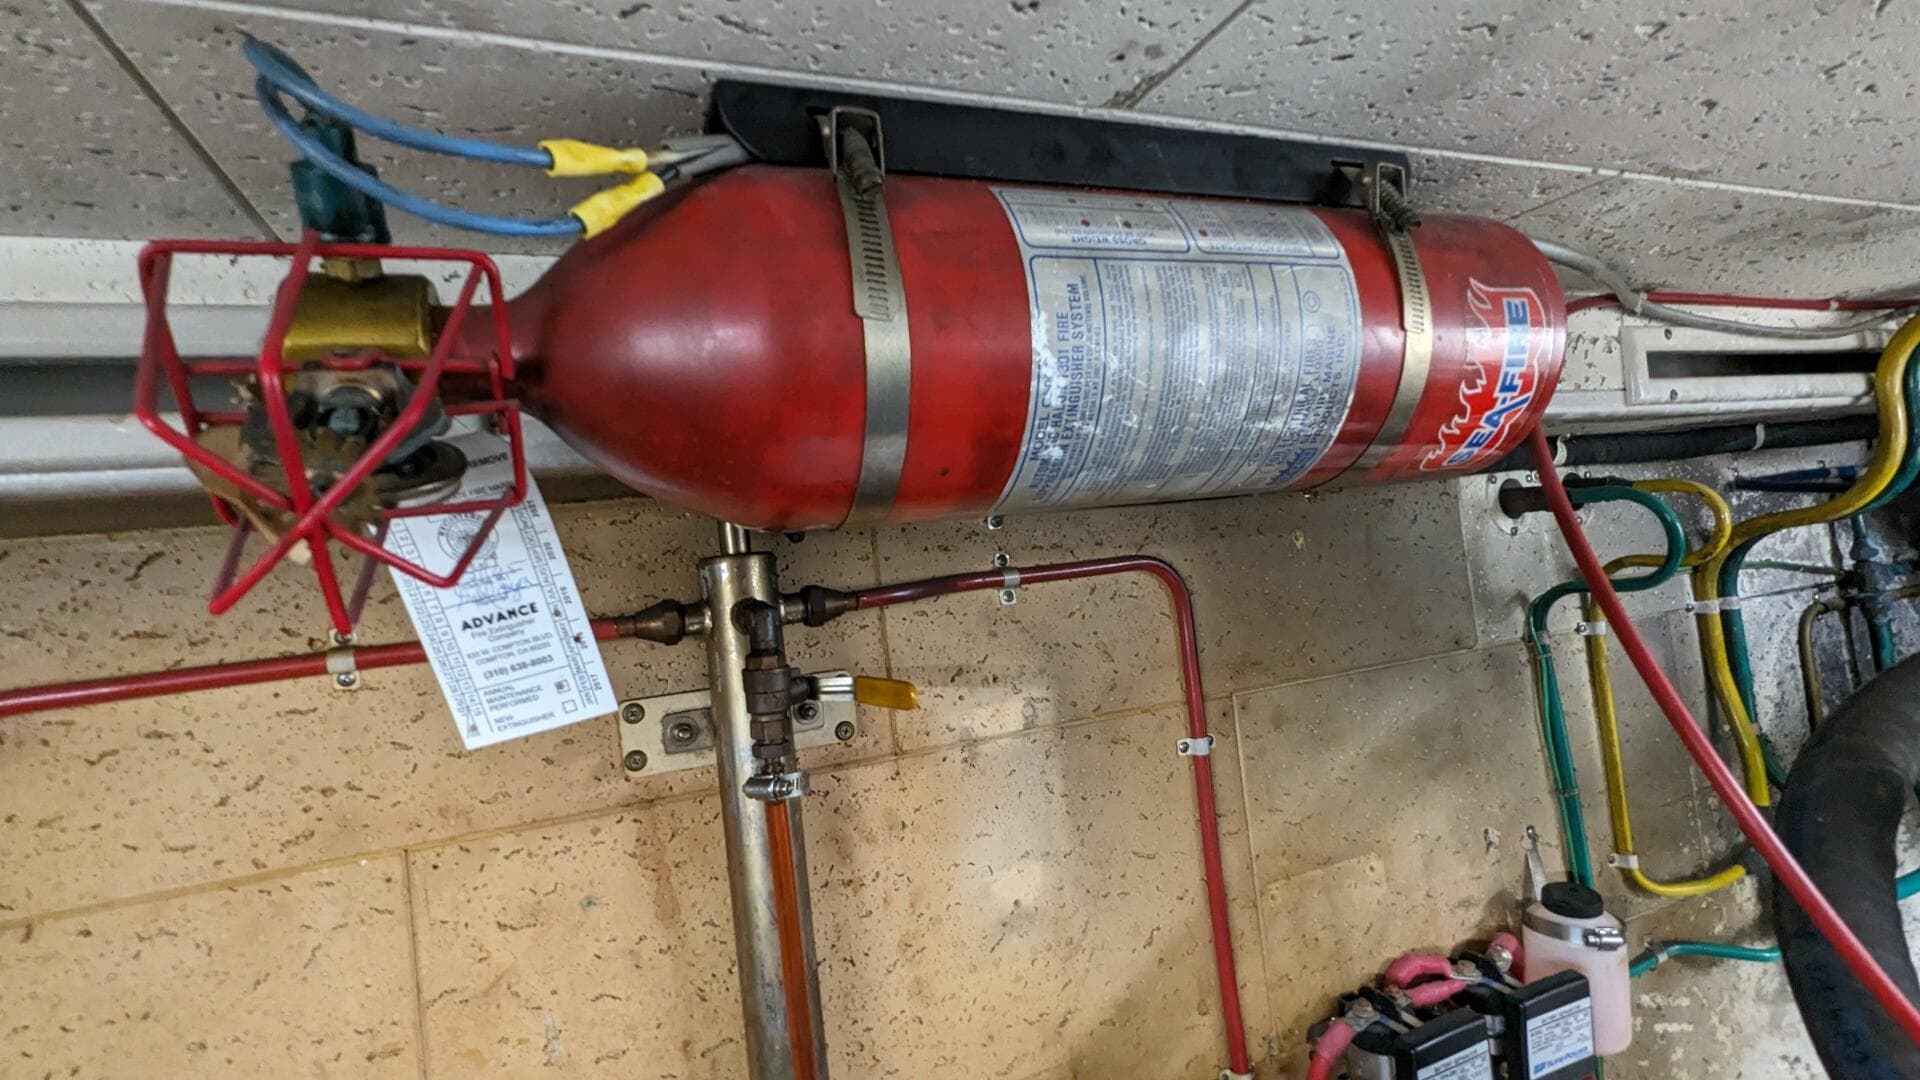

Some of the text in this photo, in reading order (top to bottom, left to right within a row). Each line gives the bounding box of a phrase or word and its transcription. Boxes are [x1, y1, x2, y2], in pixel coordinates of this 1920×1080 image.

[1066, 282, 1084, 340] SYSTEM
[1322, 324, 1336, 383] MARINE
[1336, 333, 1346, 364] INC.
[1030, 432, 1060, 488] AUTOMIC
[1056, 312, 1070, 342] FIRE
[1062, 346, 1084, 440] EXTINGUISHER
[1029, 412, 1050, 461] MODEL
[469, 452, 509, 468] EMOVE
[538, 566, 550, 584] AUG
[462, 602, 540, 631] ADVANCE
[488, 618, 536, 635] Extinguisher
[560, 622, 569, 638] MAY
[487, 629, 525, 644] Company
[492, 636, 531, 654] COMPTON
[483, 684, 516, 697] ANNUAL
[578, 674, 588, 690] FEB
[590, 673, 602, 691] 2017
[486, 684, 544, 704] MAINTENANCE
[488, 694, 540, 712] PERFORMED
[584, 691, 594, 705] JAN
[494, 714, 513, 724] NEW
[497, 711, 556, 732] EXTINGUISHER
